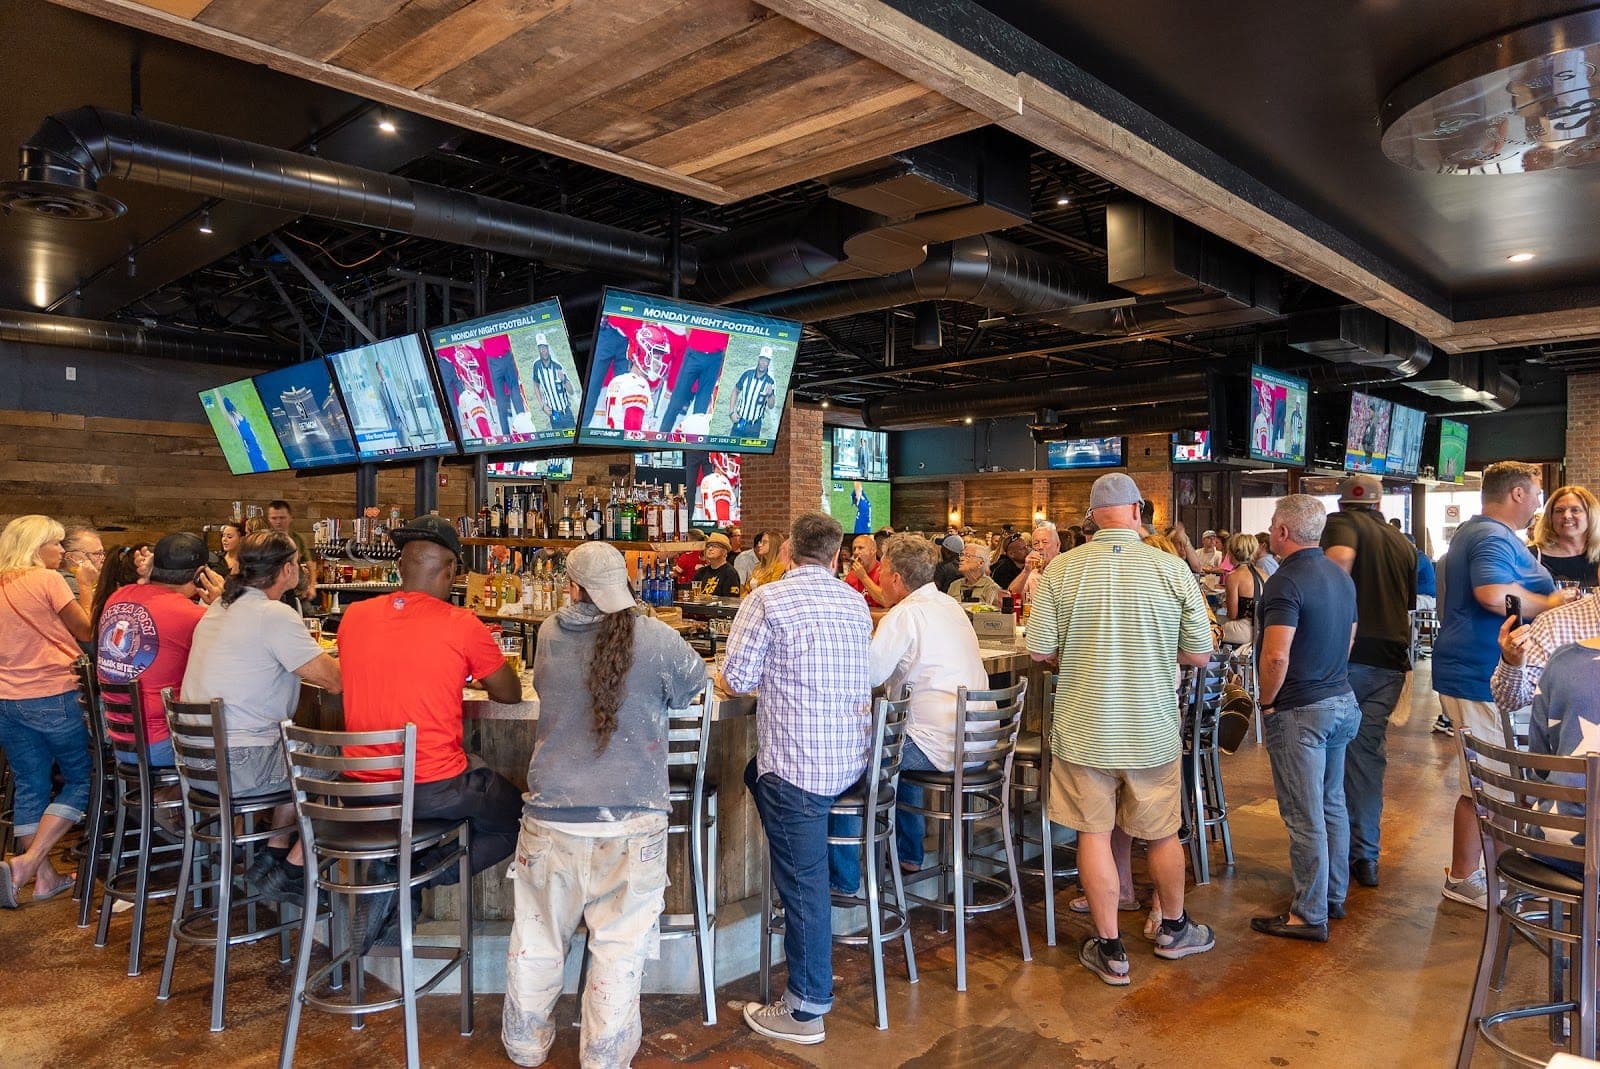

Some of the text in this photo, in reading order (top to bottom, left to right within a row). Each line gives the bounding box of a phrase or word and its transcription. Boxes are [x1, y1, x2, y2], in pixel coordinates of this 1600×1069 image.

[451, 329, 478, 342] MONDAY
[478, 324, 499, 336] NIGHT
[499, 315, 536, 331] FOOTBALL
[643, 307, 690, 323] MONDAY
[690, 315, 722, 328] NIGHT
[722, 321, 770, 336] FOOTBALL
[134, 606, 156, 636] PORT
